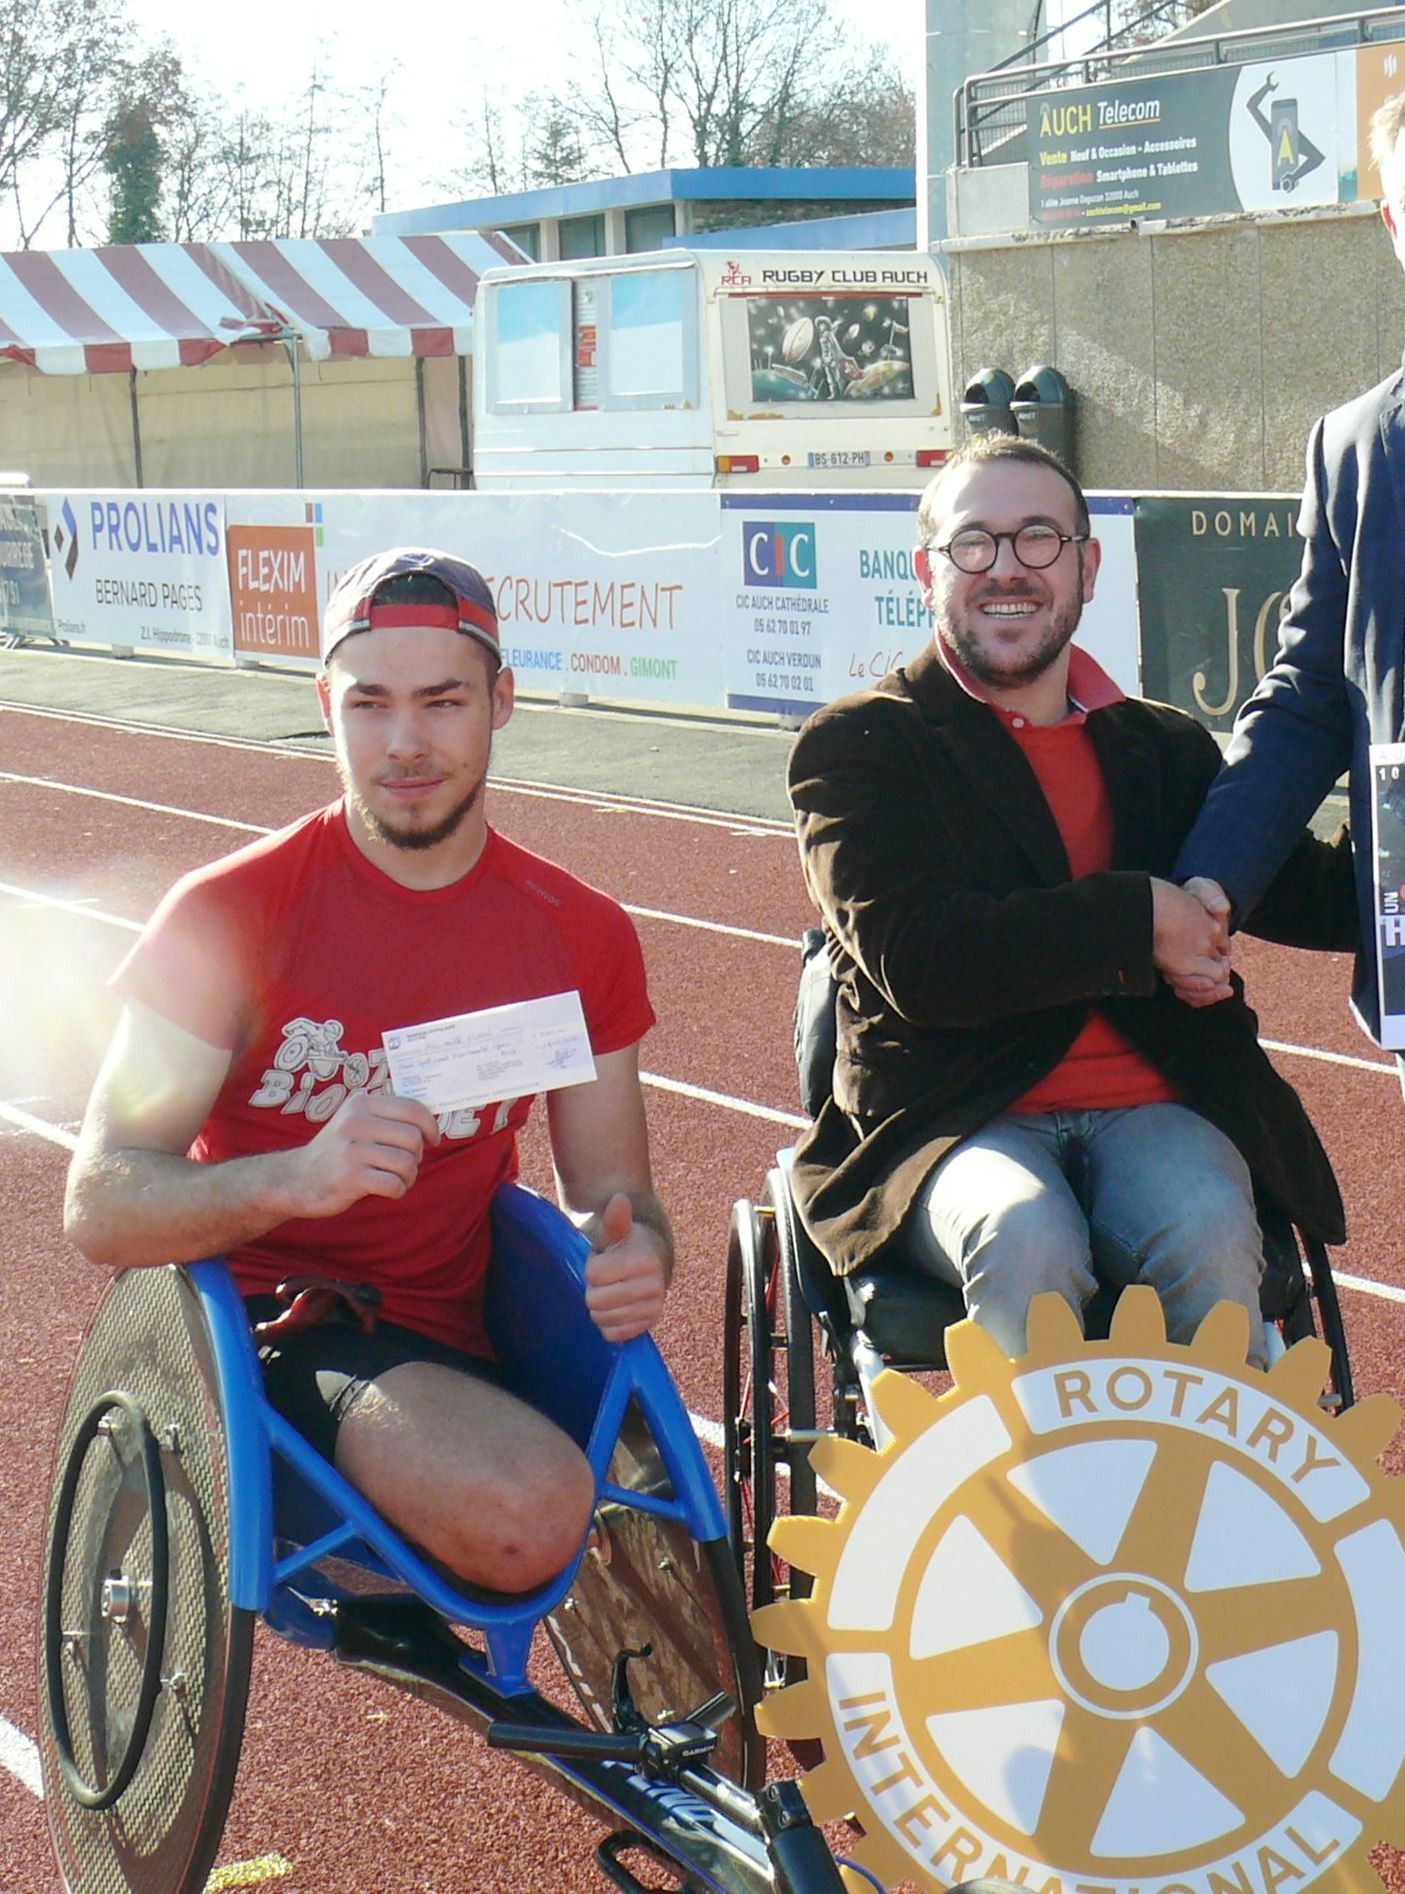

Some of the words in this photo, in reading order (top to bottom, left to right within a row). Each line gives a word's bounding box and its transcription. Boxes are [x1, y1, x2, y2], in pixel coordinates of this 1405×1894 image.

[1040, 104, 1092, 138] AUCH
[1097, 99, 1160, 125] Telecom
[1040, 151, 1067, 166] Vente
[721, 275, 751, 286] RCA
[763, 270, 824, 285] RUGBY
[832, 270, 877, 283] CLUB
[882, 271, 927, 283] AUCH
[91, 502, 220, 556] PROLIANS
[1192, 511, 1293, 537] DOMAI
[750, 532, 810, 578] CIC
[860, 550, 917, 580] BANQU
[238, 549, 306, 593] FLEXIM
[96, 579, 157, 608] BERNARD
[487, 576, 682, 630] CRUTEMENT
[736, 594, 750, 609] CIC
[751, 595, 774, 611] AUCH
[875, 590, 935, 629] TÉLÉP
[239, 600, 309, 648] intérim
[754, 618, 765, 633] 05
[766, 618, 776, 634] 62
[778, 620, 788, 635] 70
[789, 620, 800, 635] 01
[801, 621, 811, 636] 97
[570, 653, 621, 676] CONDOM
[630, 657, 678, 680] GIMONT
[747, 650, 758, 665] CIC
[760, 651, 784, 667] AUCH
[787, 652, 821, 669] VERDUN
[849, 653, 865, 677] Le
[756, 673, 767, 688] 05
[768, 674, 778, 689] 62
[779, 674, 790, 690] 70
[791, 676, 802, 691] 02
[803, 677, 814, 691] 01
[1384, 892, 1399, 914] UN
[1053, 1366, 1341, 1484] ROTARY
[839, 1691, 1340, 1894] INTERNNAL
